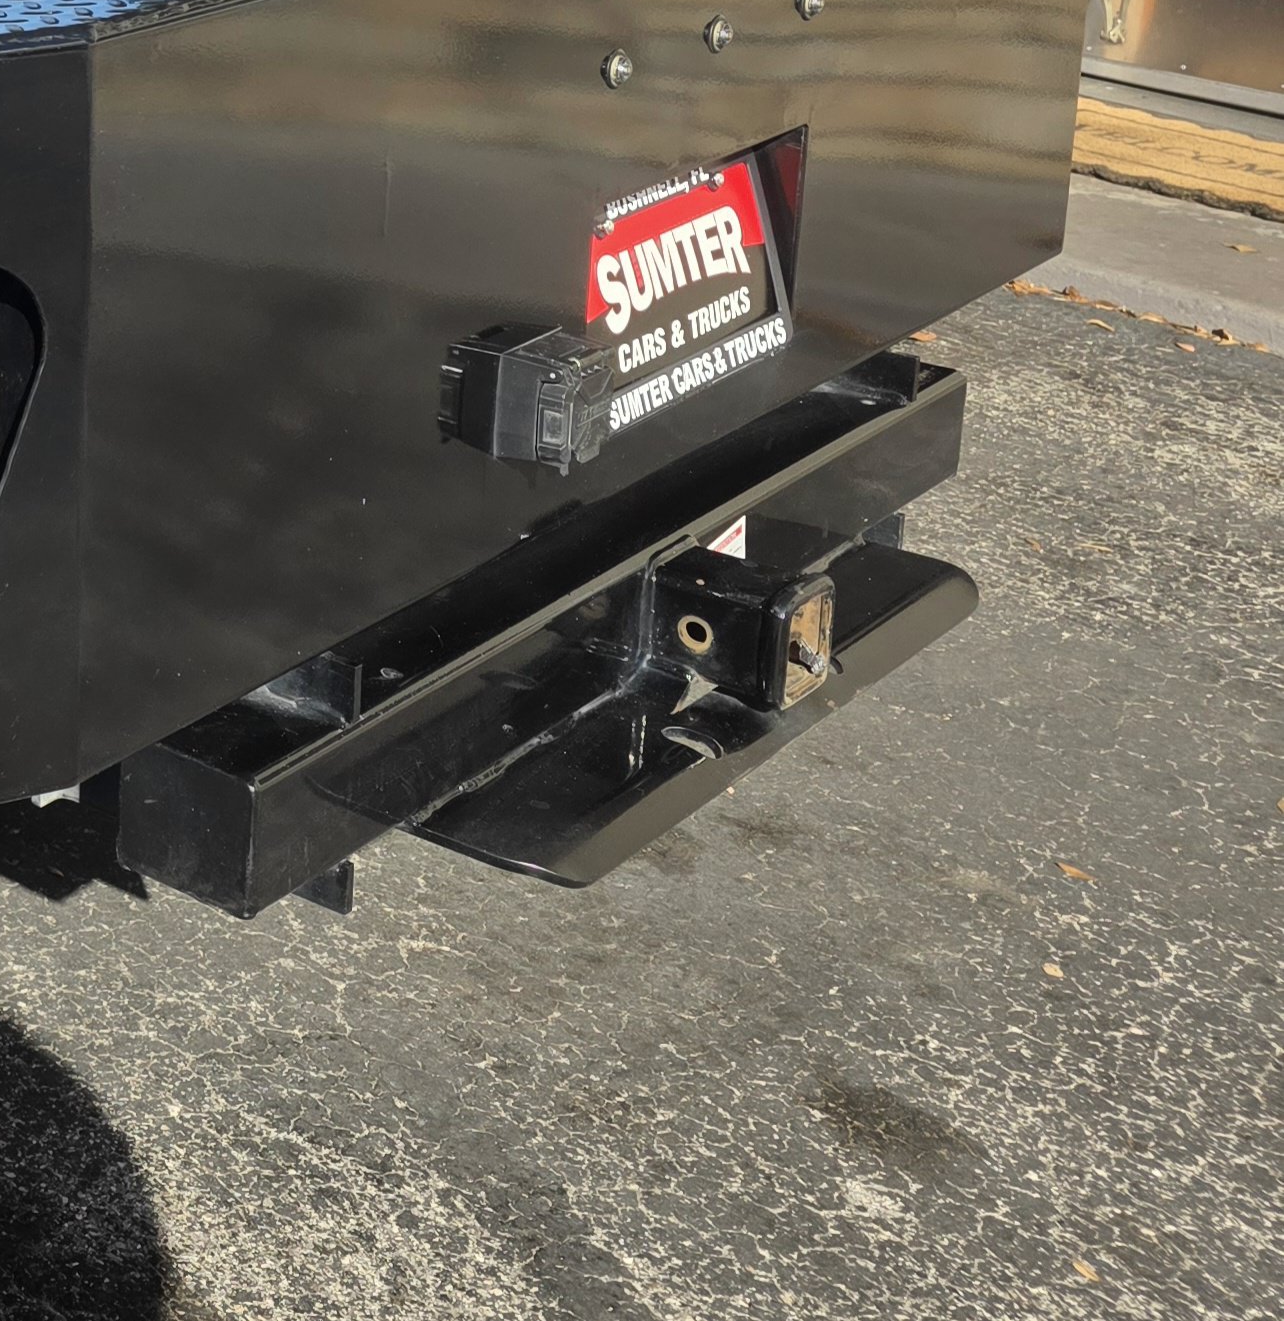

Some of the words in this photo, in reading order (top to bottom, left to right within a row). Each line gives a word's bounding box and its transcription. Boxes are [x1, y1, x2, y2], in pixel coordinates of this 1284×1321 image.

[596, 205, 752, 335] SUMTER
[609, 374, 674, 431] SUMTER
[670, 351, 715, 395] CARS
[724, 317, 788, 369] TRUCKS
[618, 327, 667, 374] CARS
[671, 319, 686, 349] &
[687, 286, 751, 340] TRUCKS
